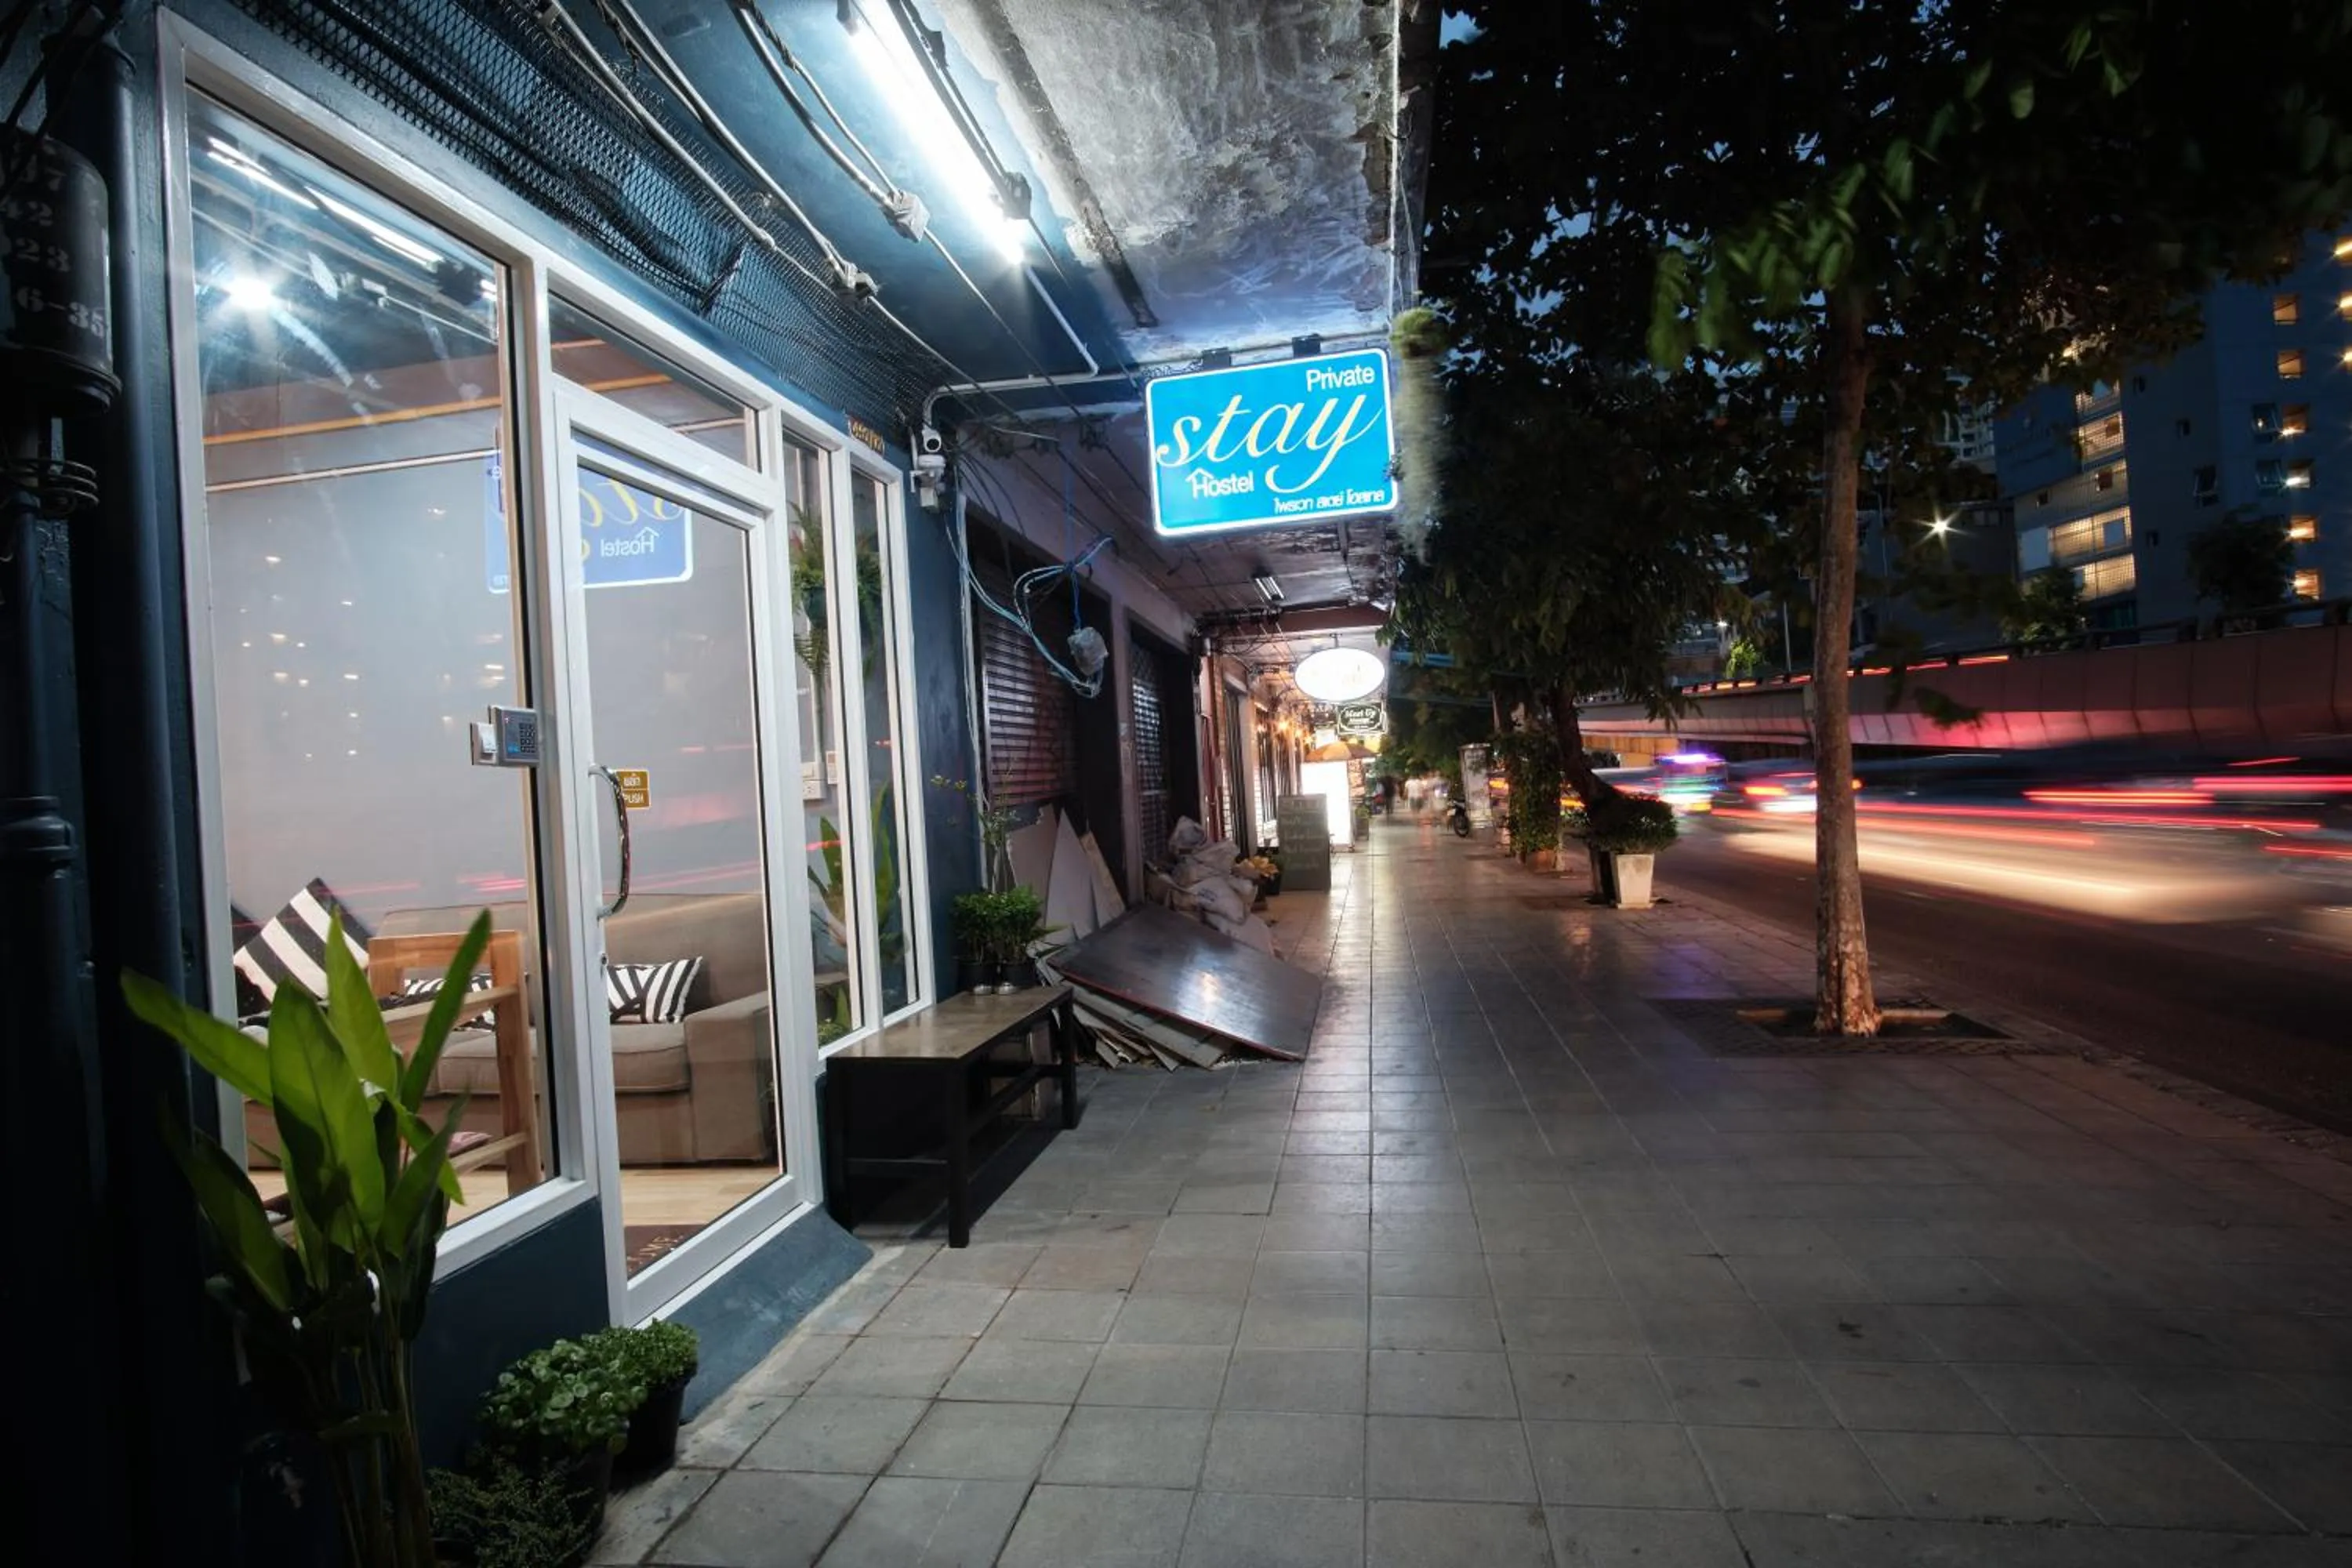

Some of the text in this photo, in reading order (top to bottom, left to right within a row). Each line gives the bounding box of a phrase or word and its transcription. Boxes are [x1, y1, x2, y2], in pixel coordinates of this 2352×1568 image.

[1305, 365, 1376, 392] Private
[1156, 394, 1385, 494] stay
[1189, 469, 1255, 499] Hostel
